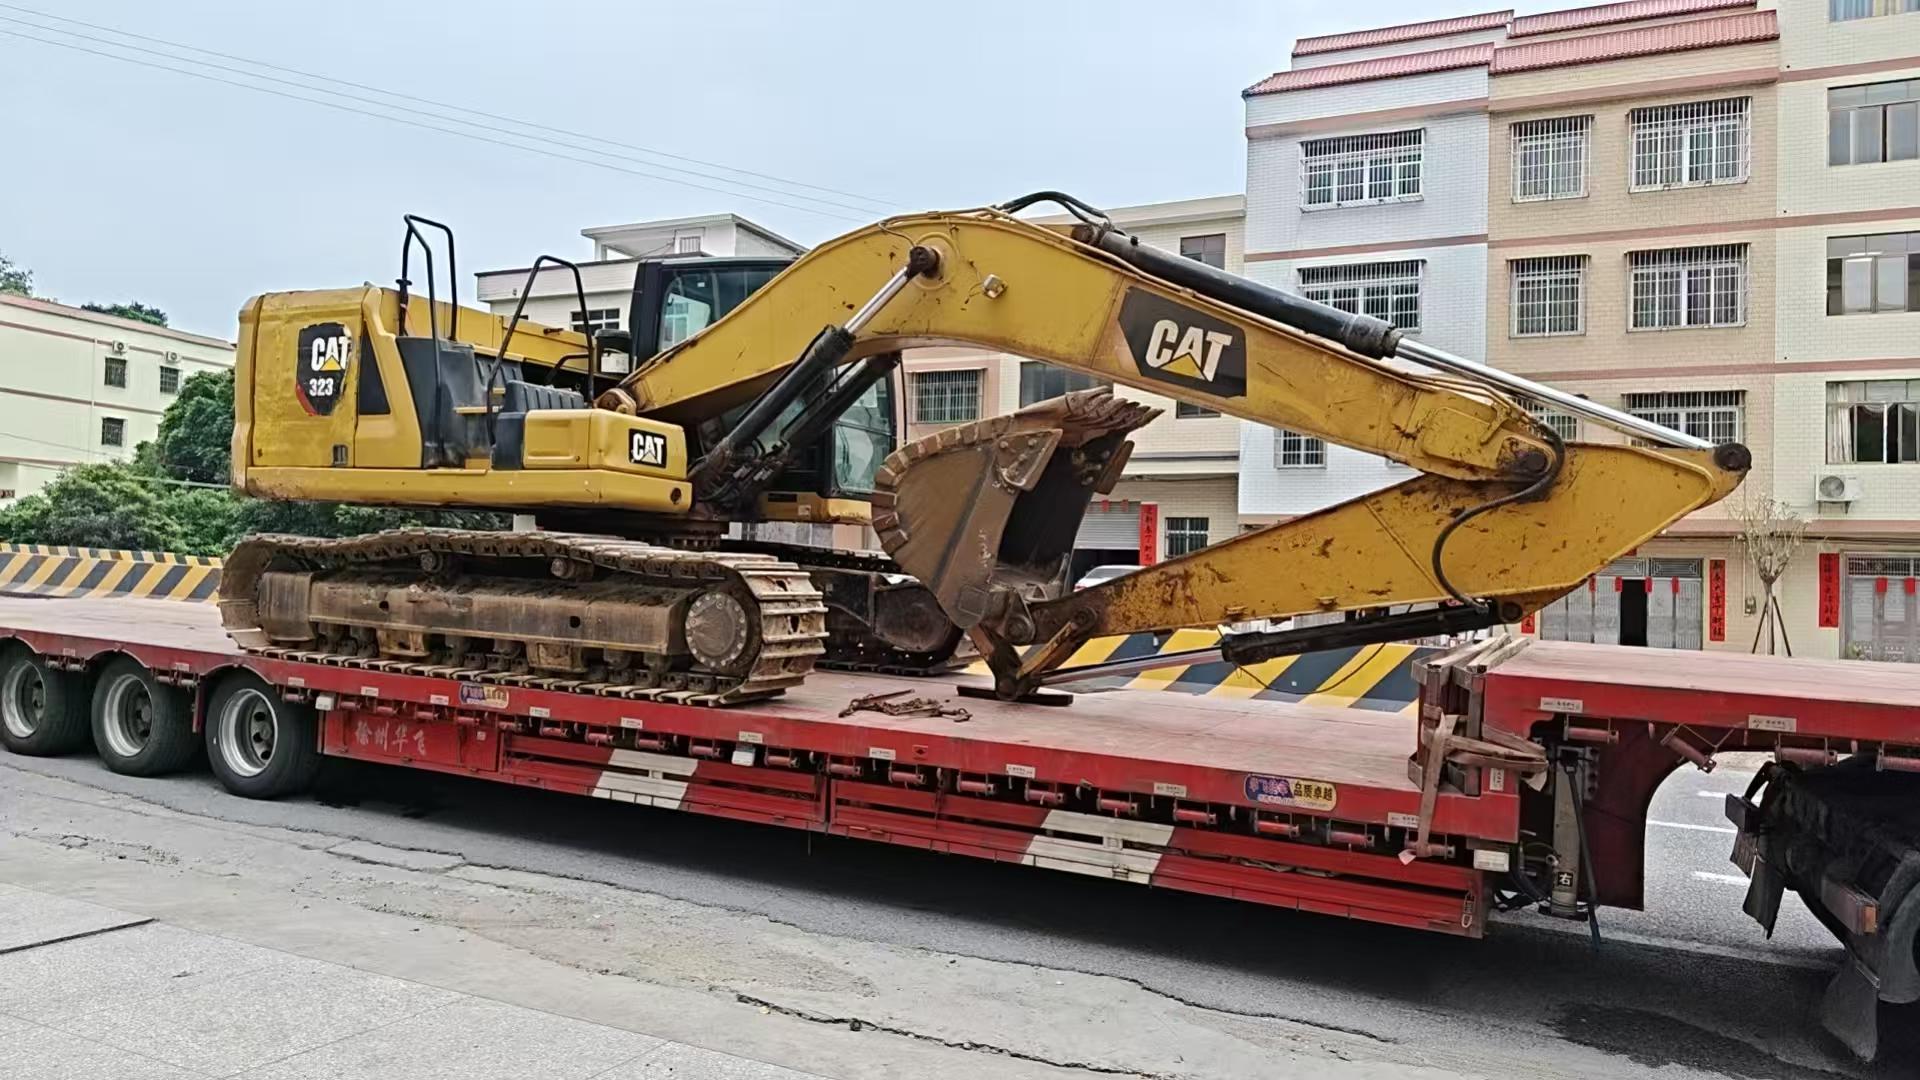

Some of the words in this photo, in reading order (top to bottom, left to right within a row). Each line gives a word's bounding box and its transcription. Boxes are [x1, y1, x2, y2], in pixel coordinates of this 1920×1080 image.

[311, 336, 352, 371] CAT
[1145, 319, 1233, 382] CAT
[309, 378, 334, 396] 323
[632, 433, 664, 464] CAT
[1293, 780, 1333, 801] 品质卓越
[1559, 873, 1571, 886] 右
